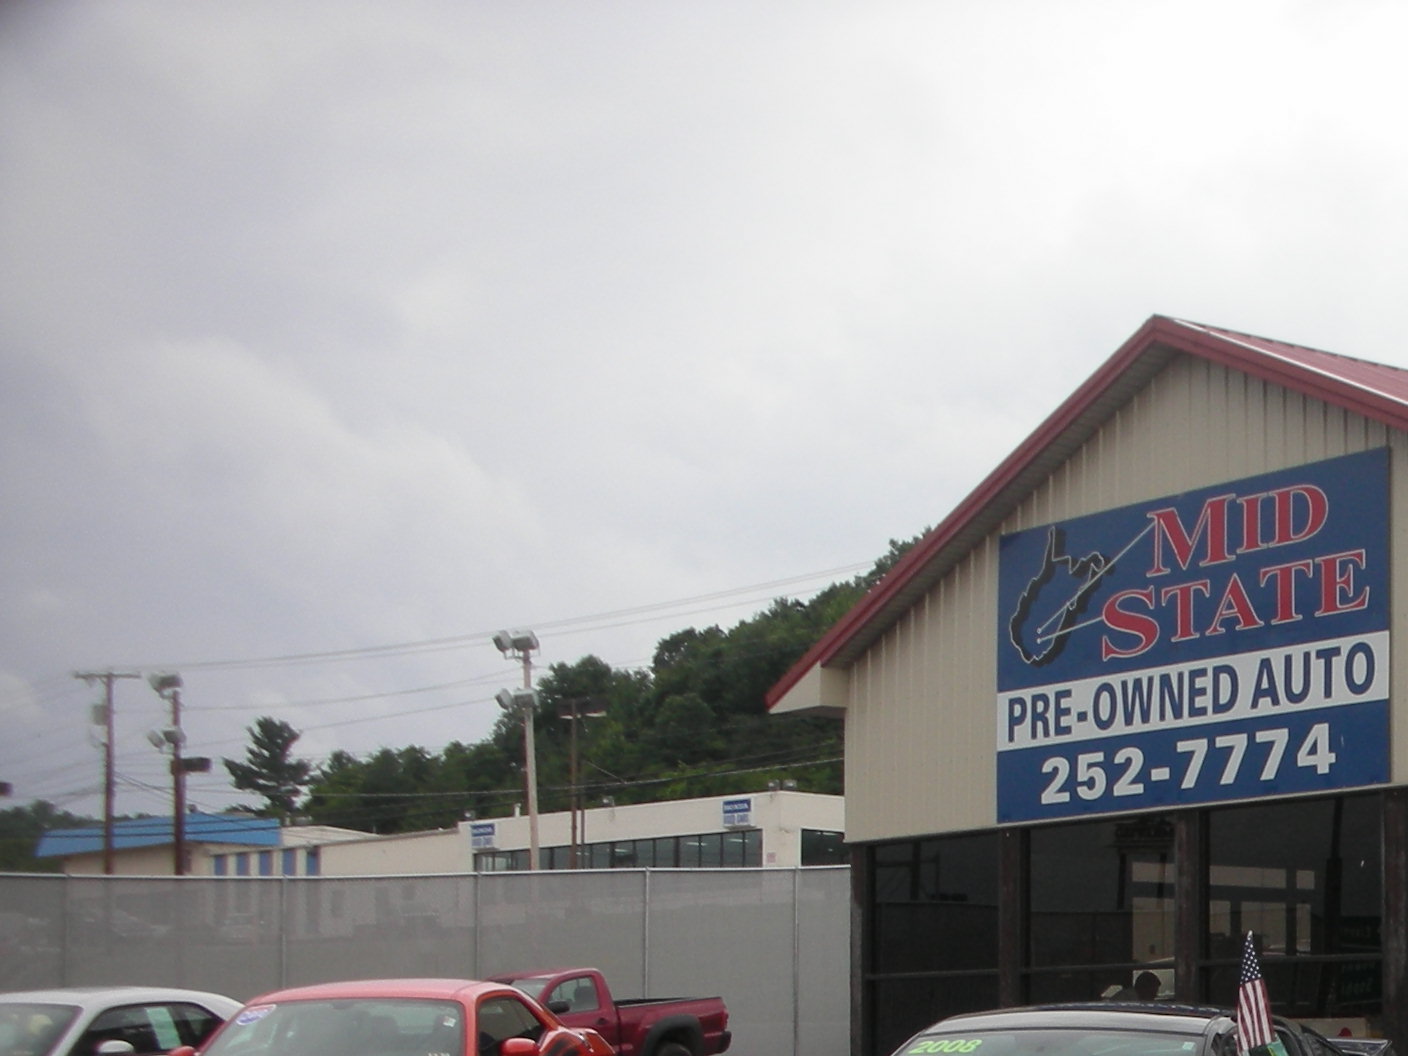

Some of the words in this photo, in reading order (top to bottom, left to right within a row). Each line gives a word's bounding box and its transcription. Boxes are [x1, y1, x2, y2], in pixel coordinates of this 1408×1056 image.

[1146, 484, 1328, 578] MID
[1102, 549, 1370, 661] STATE
[1007, 664, 1240, 743] PRE-OWNED
[1250, 641, 1376, 710] AUTO
[1040, 723, 1336, 805] 252-7774
[908, 1039, 983, 1055] 2008
